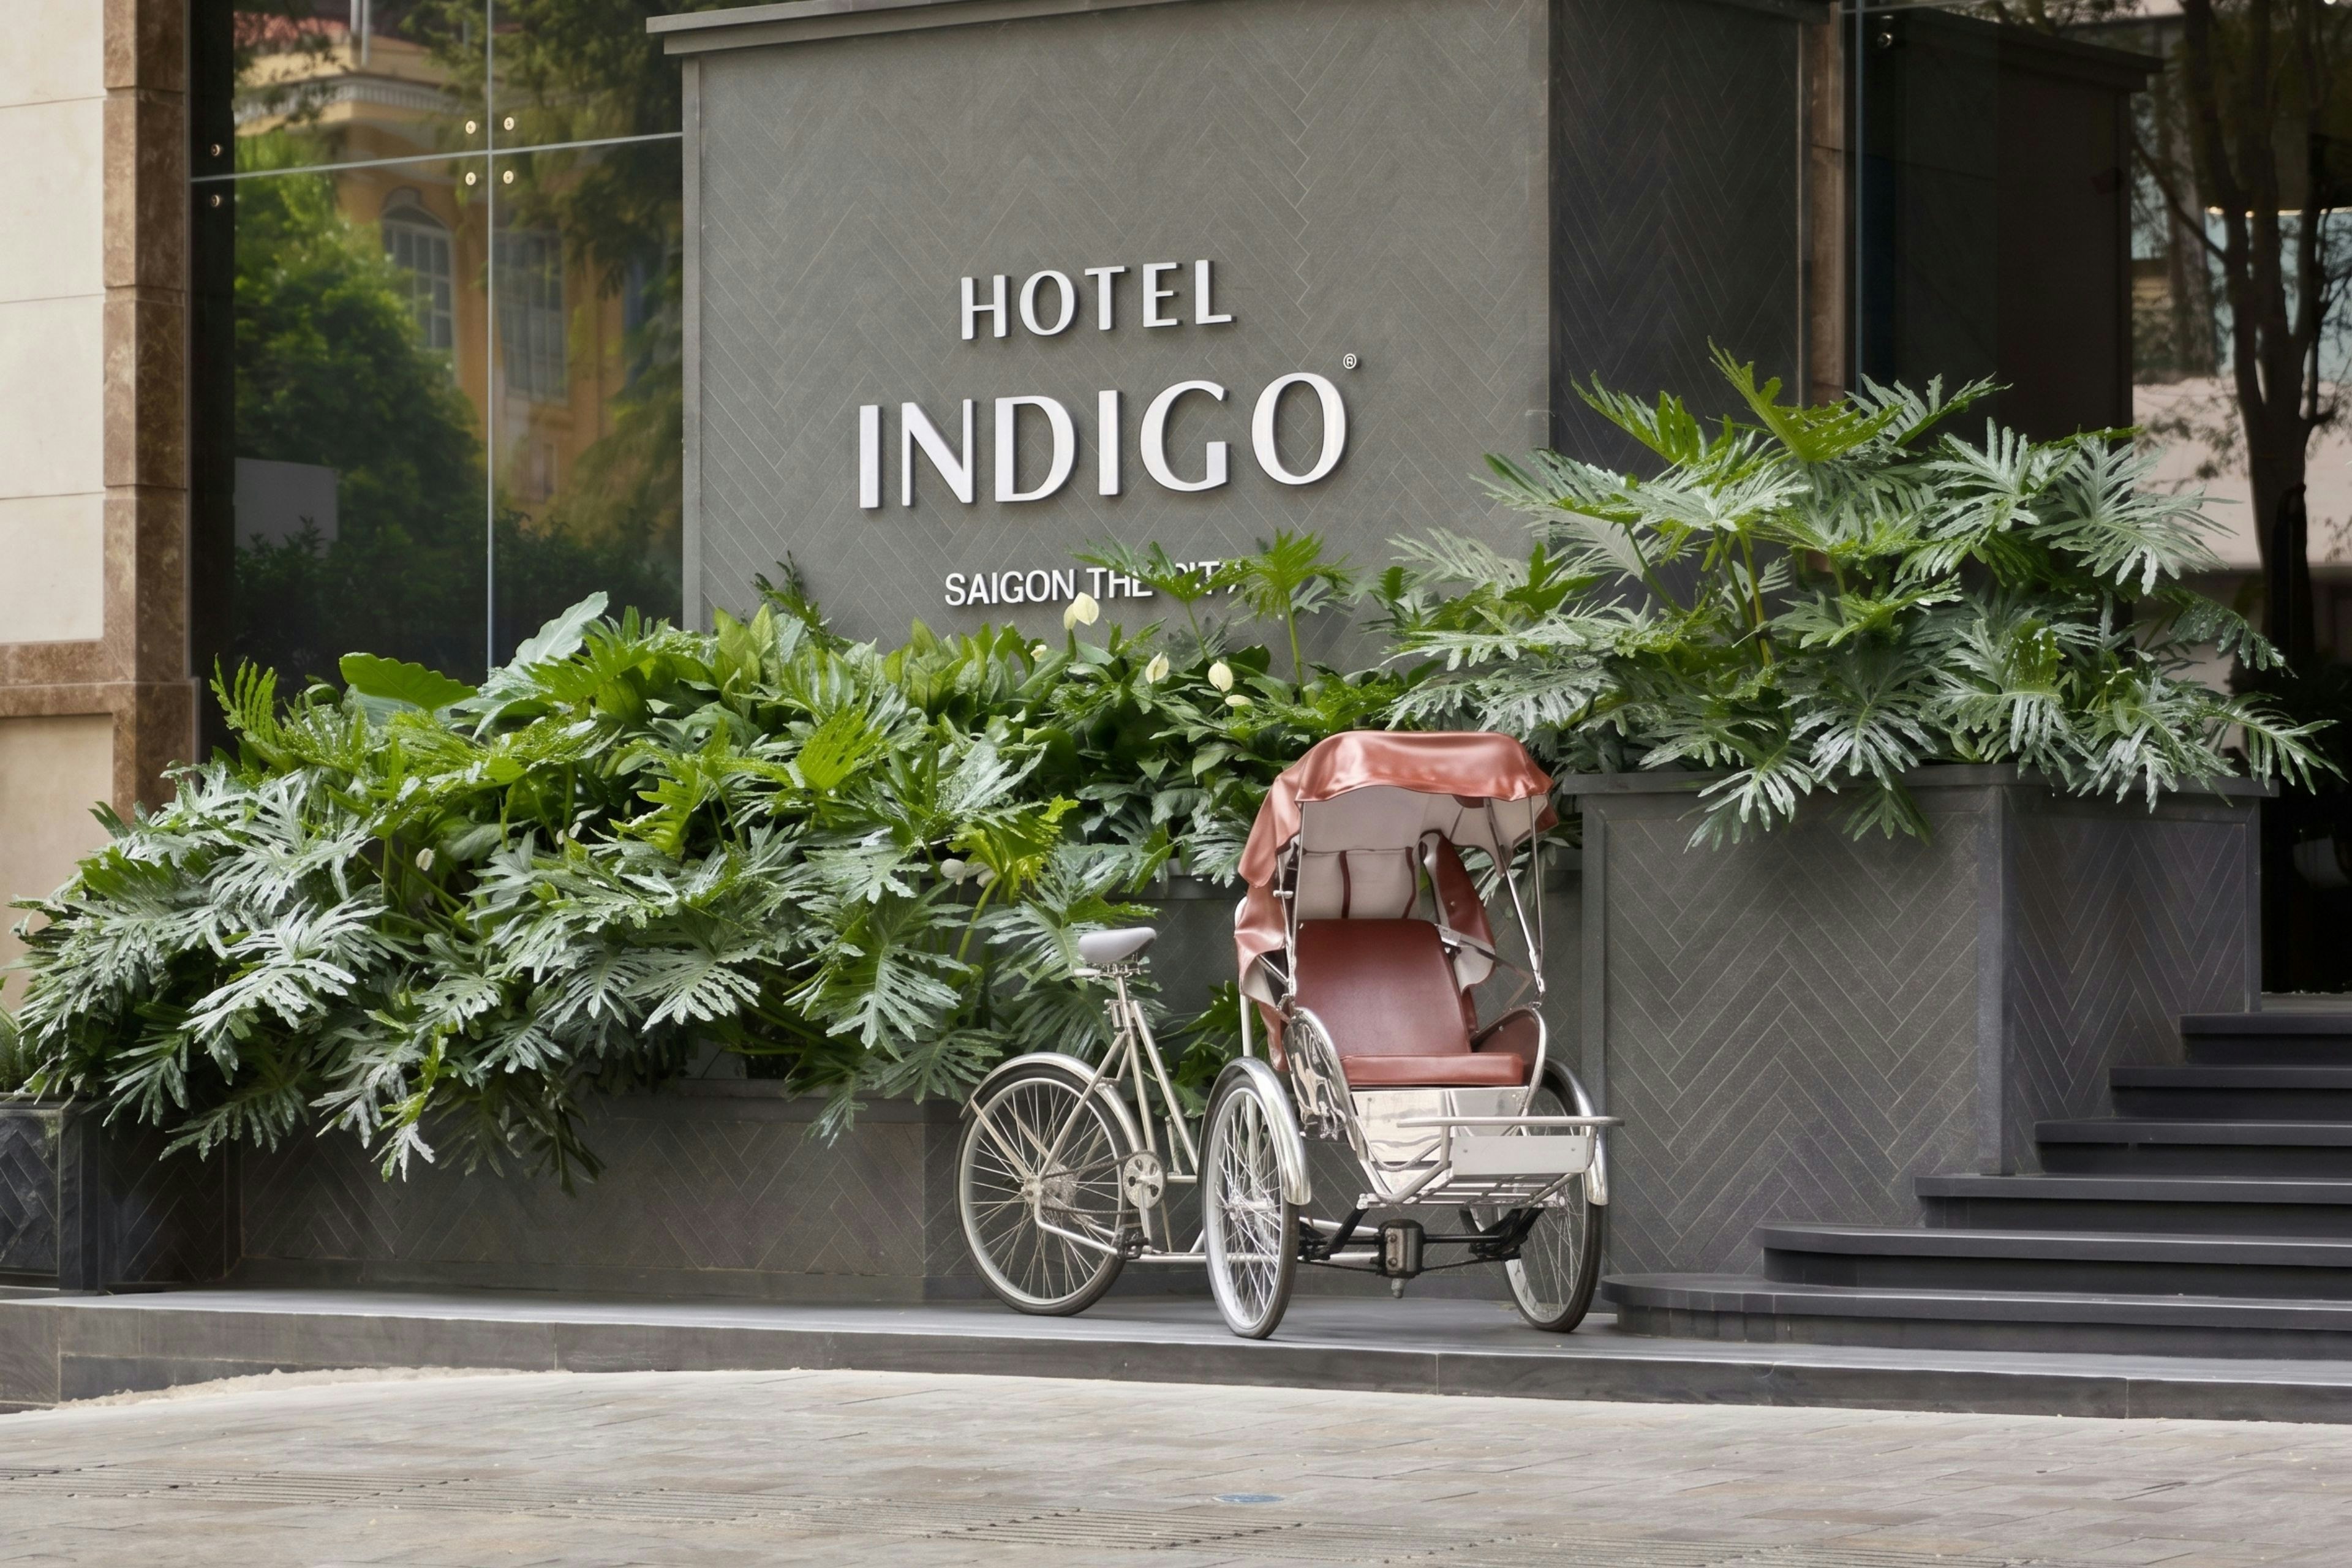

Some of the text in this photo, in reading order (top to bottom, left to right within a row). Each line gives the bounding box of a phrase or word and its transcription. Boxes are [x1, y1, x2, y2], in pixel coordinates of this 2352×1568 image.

[960, 259, 1234, 341] HOTEL
[859, 372, 1349, 510] INDIGO
[944, 568, 1075, 606] SAIGON
